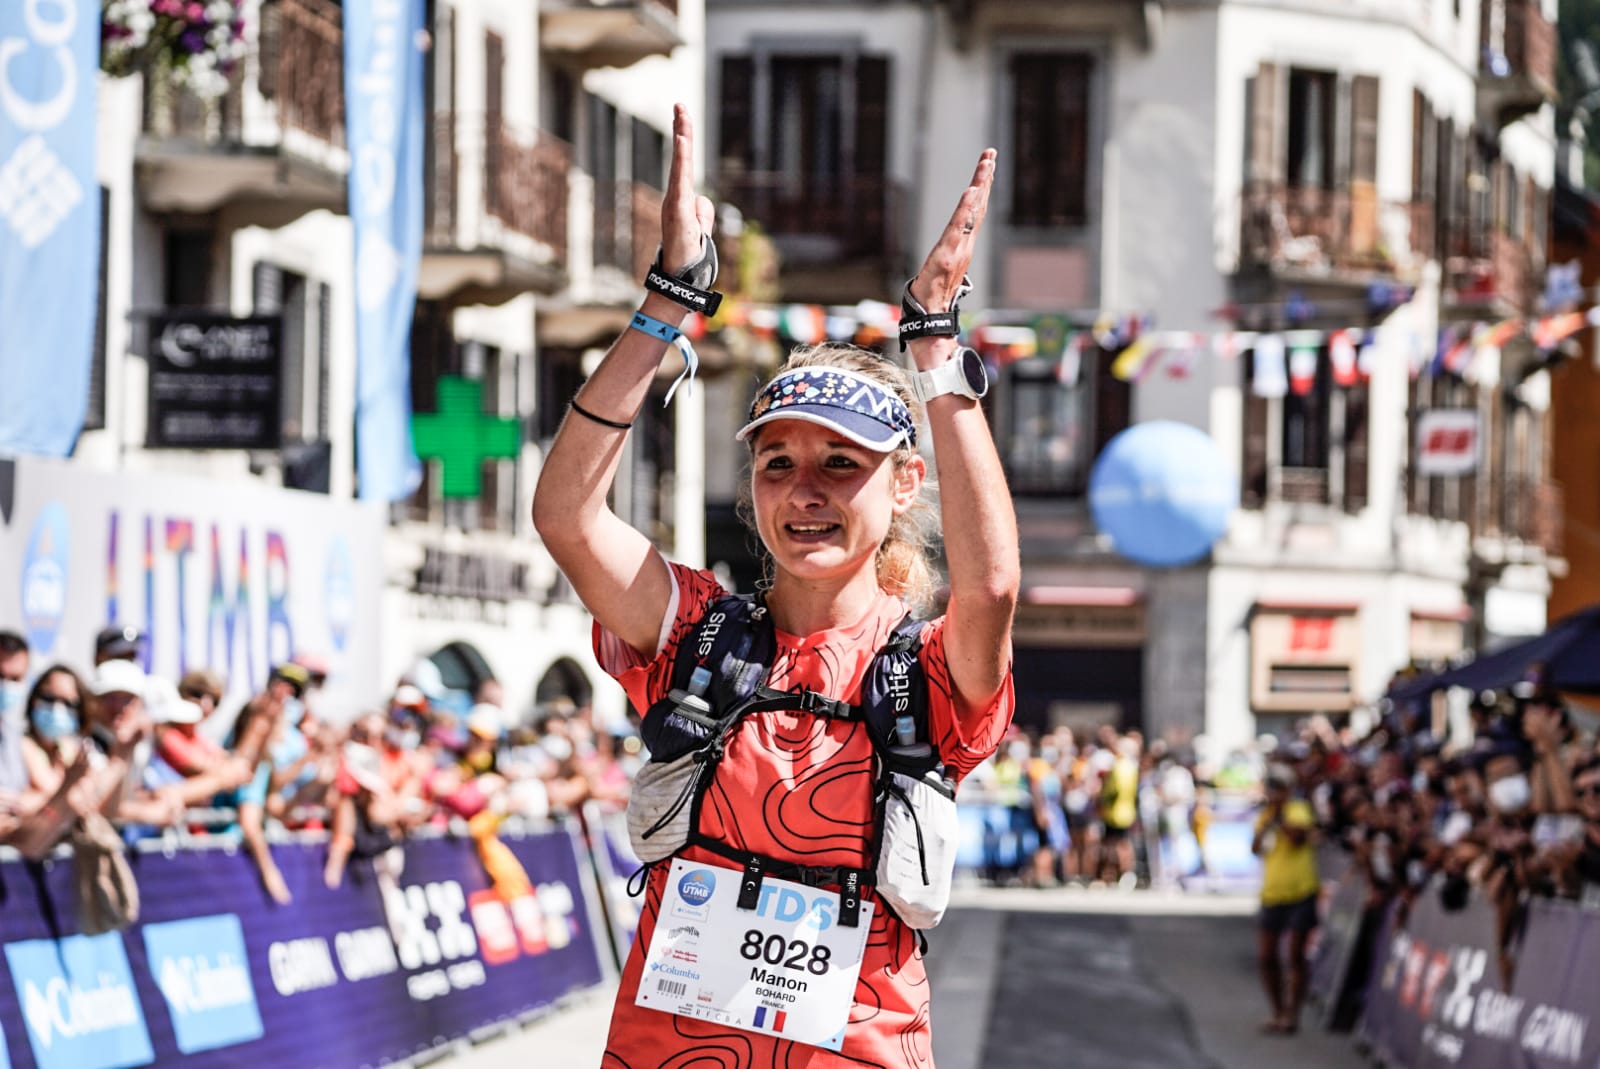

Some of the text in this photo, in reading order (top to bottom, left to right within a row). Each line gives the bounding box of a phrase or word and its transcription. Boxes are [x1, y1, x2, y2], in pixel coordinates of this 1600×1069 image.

[698, 612, 726, 656] sitis
[889, 661, 910, 712] sitis
[682, 884, 709, 898] UTMB
[756, 883, 835, 931] TDS
[740, 929, 832, 976] 8028
[659, 963, 700, 981] Columbia
[750, 967, 808, 993] Manon
[755, 987, 796, 1003] BOHARD
[761, 999, 785, 1009] FRANCE
